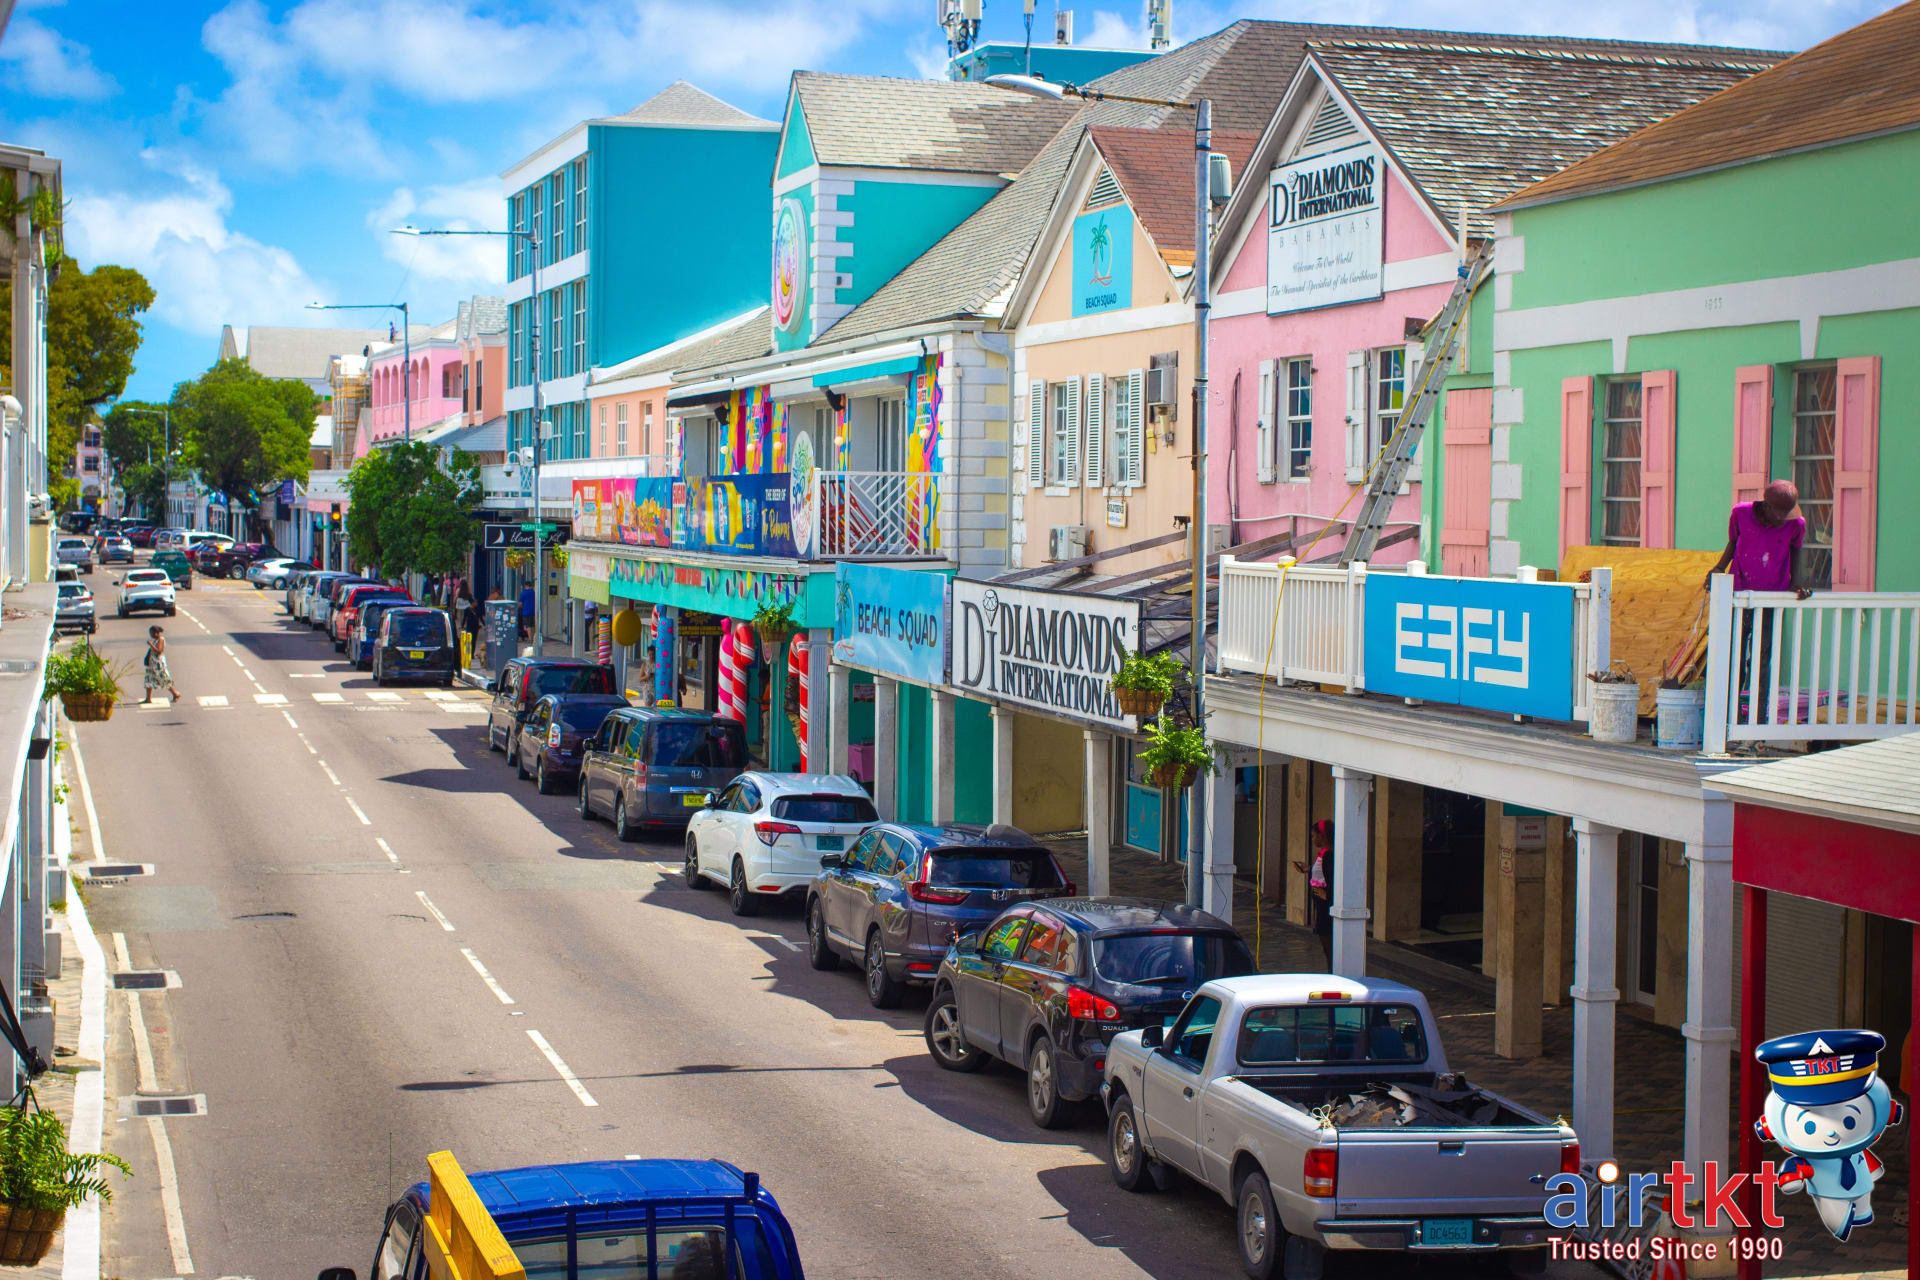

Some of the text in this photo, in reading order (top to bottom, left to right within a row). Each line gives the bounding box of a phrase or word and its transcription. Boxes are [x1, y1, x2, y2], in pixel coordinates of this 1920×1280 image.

[1298, 155, 1375, 201] DIAMONDS
[1298, 186, 1375, 220] INTERNATIONAL
[1279, 216, 1370, 249] BAHAMAS
[1292, 262, 1315, 273] Welcome
[1323, 256, 1335, 268] Our
[1335, 251, 1353, 265] World
[1348, 269, 1378, 284] Caribbean
[1086, 293, 1117, 309] BEACH SQUAD
[510, 531, 534, 544] blanc
[858, 602, 938, 651] BEACH SQUAD
[1000, 602, 1127, 675] DIAMONDS
[1000, 659, 1125, 721] INTERNATIONAL
[1430, 1226, 1468, 1240] DC4563
